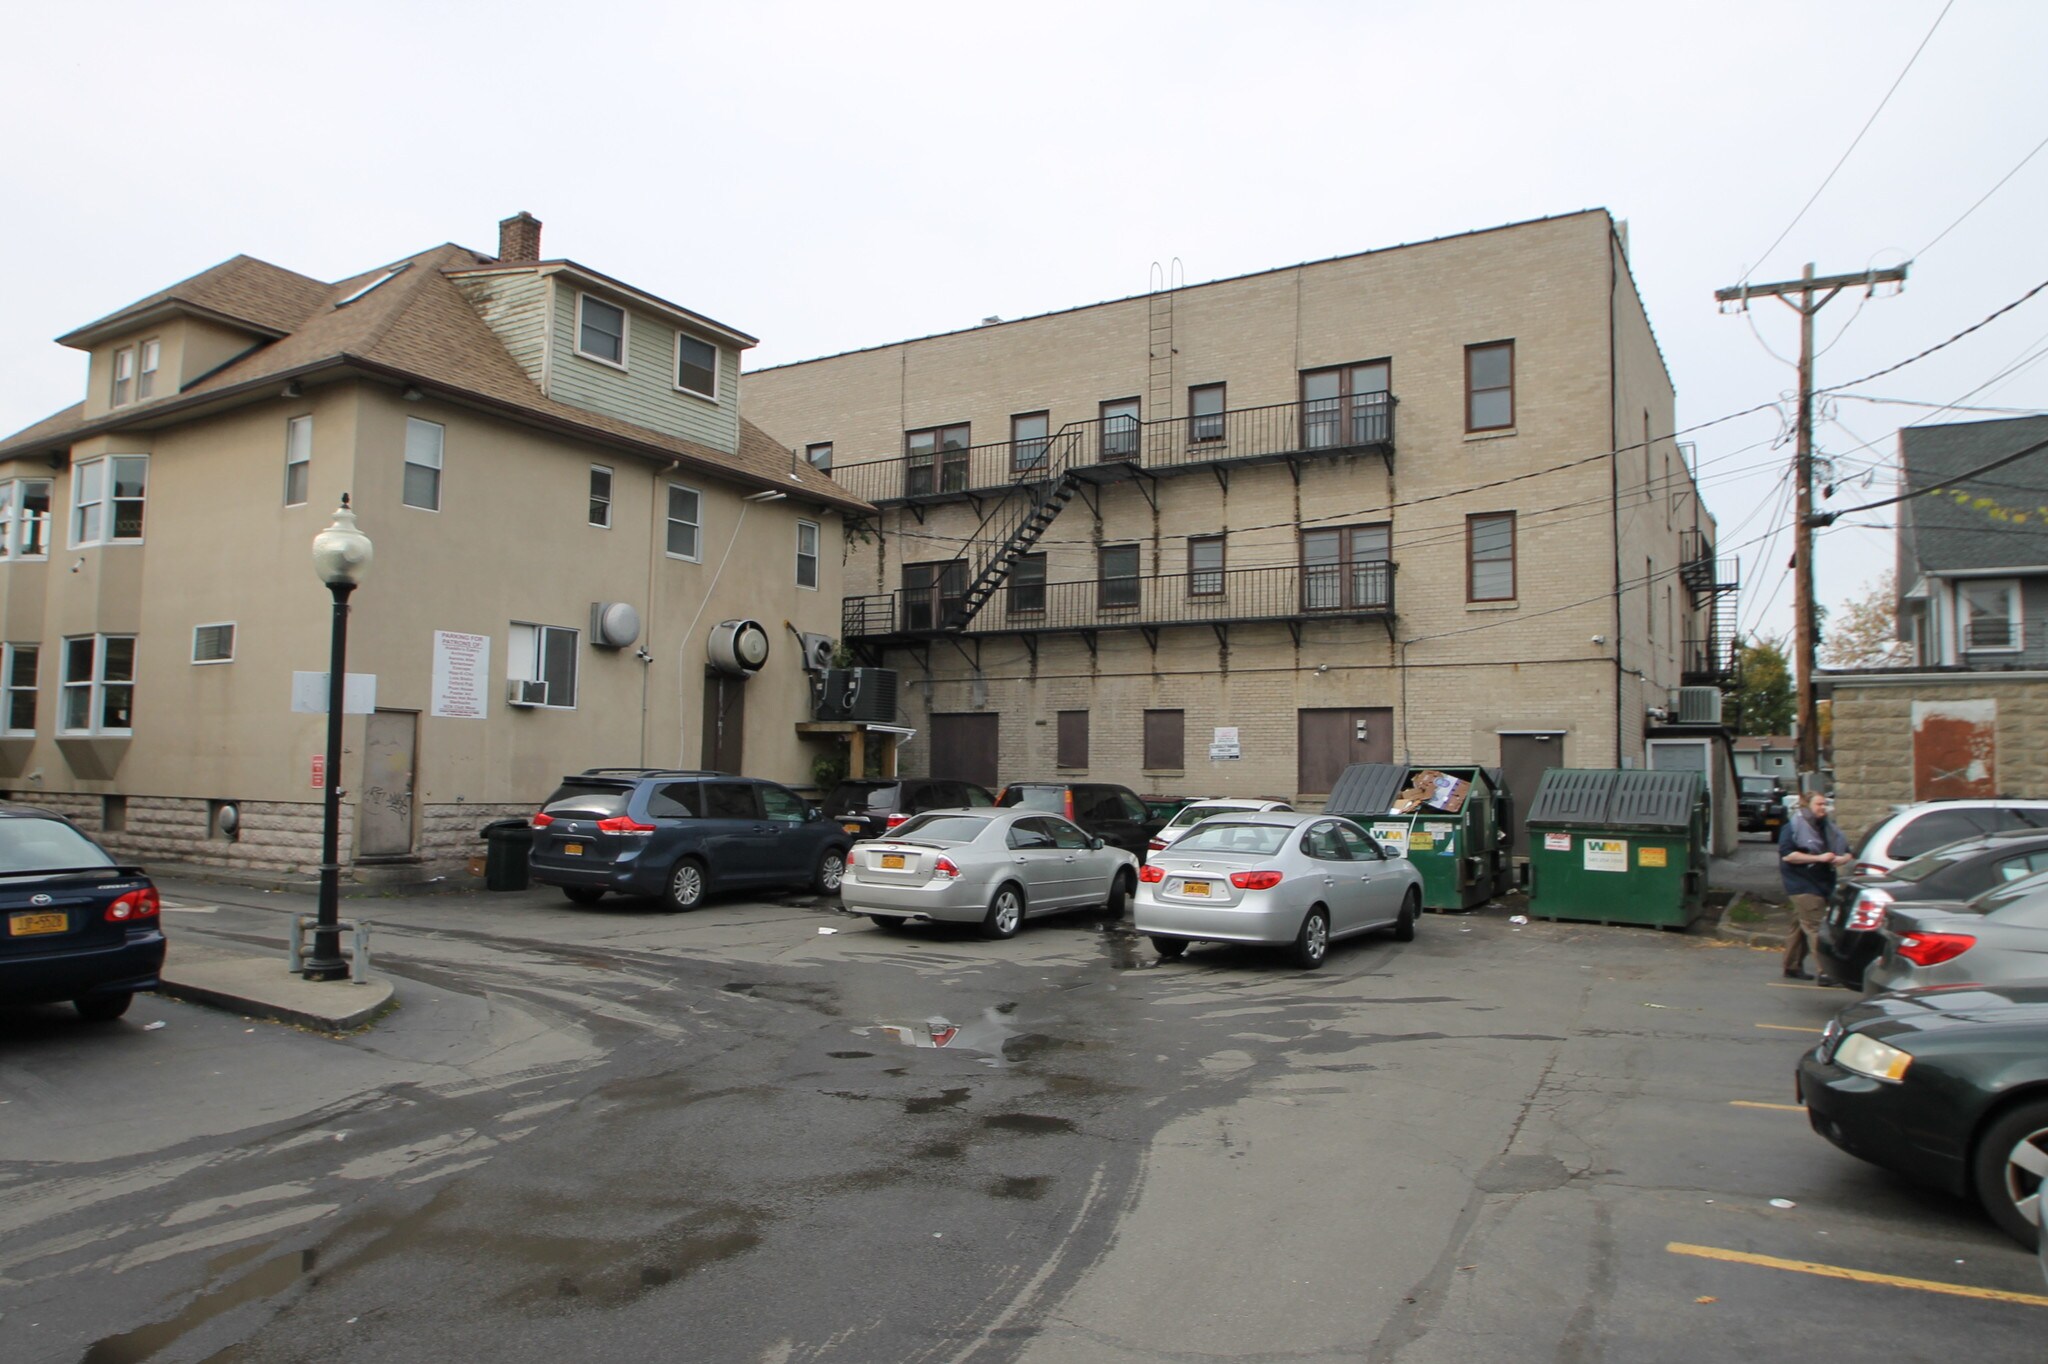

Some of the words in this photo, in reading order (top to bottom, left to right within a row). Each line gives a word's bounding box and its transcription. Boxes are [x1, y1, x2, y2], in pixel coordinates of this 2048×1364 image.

[441, 639, 471, 647] PATRONS
[1373, 830, 1403, 840] WM
[1588, 841, 1622, 852] WM
